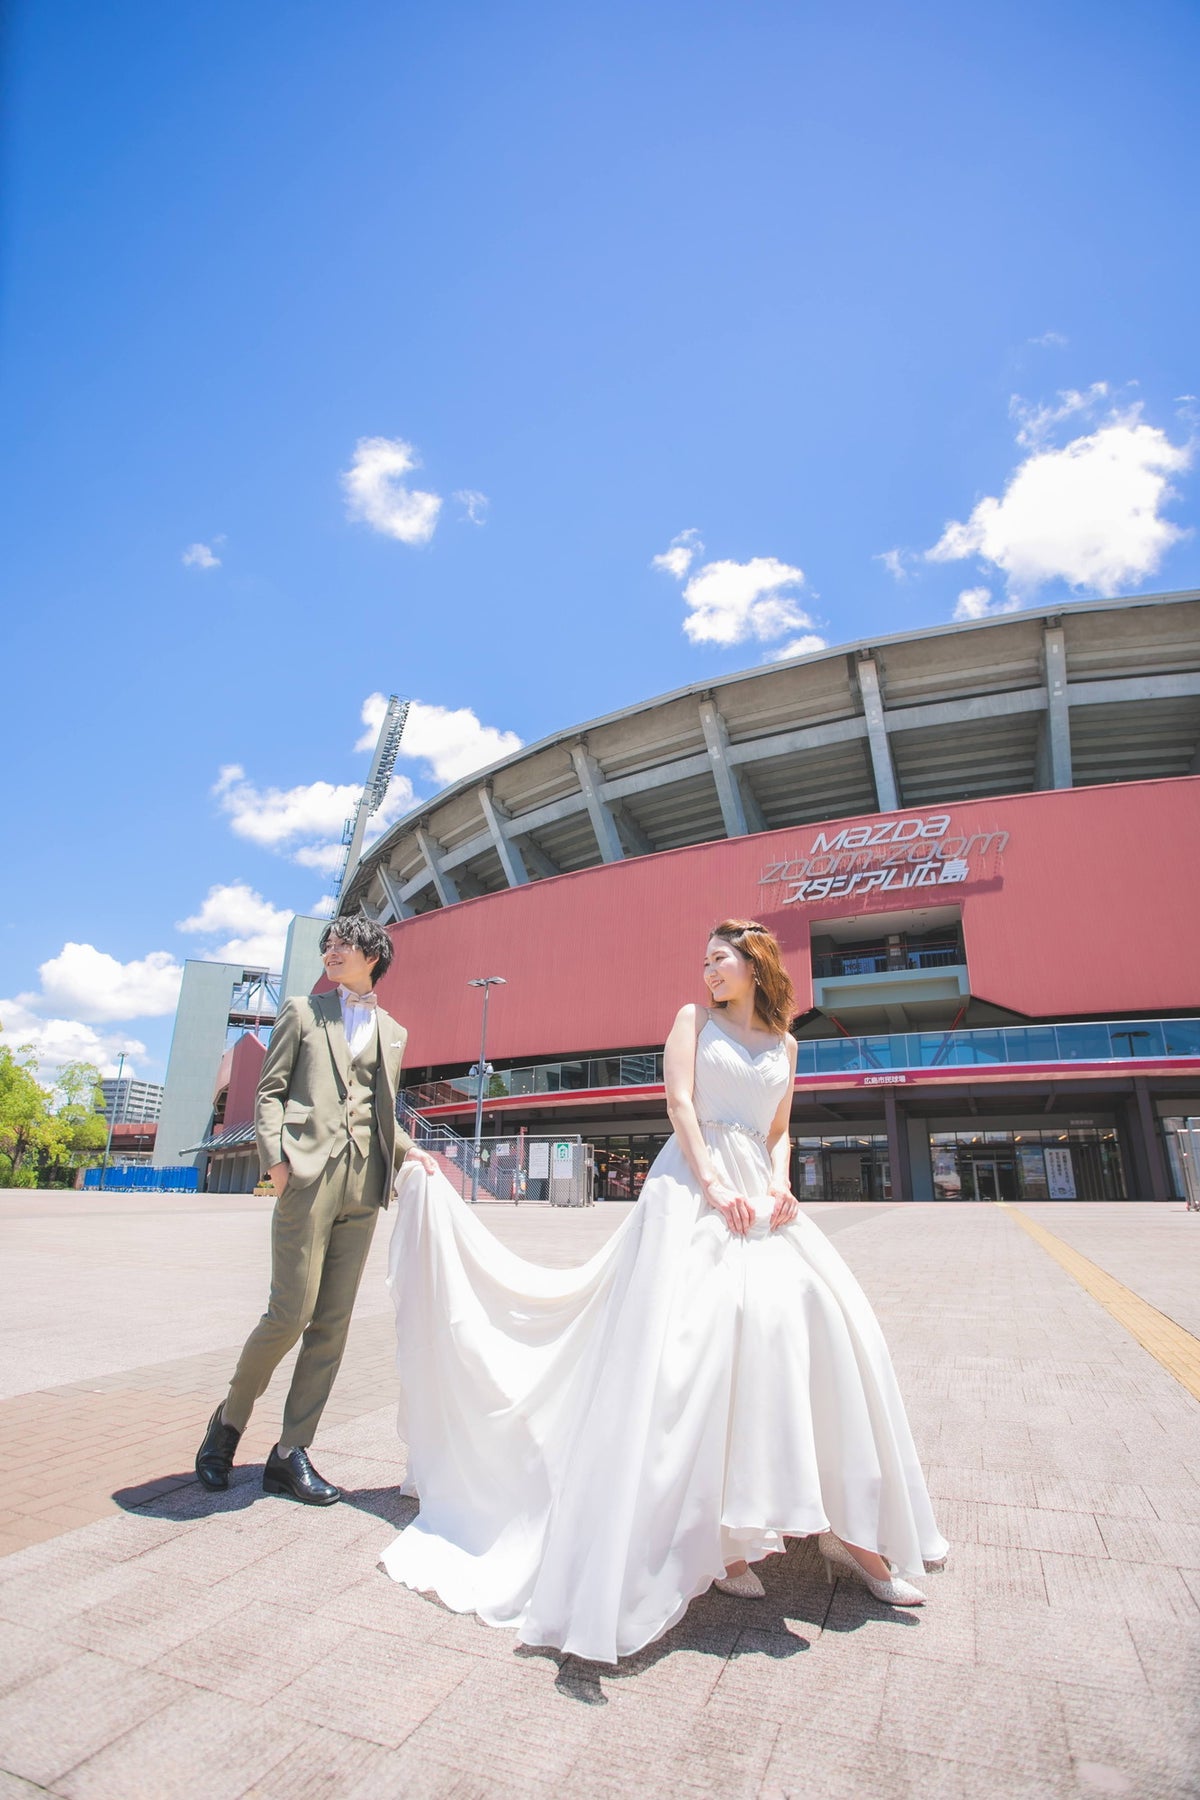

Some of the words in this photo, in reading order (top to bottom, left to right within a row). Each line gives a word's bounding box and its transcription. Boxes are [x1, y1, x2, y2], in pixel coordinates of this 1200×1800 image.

[783, 858, 969, 904] スタジアム広島
